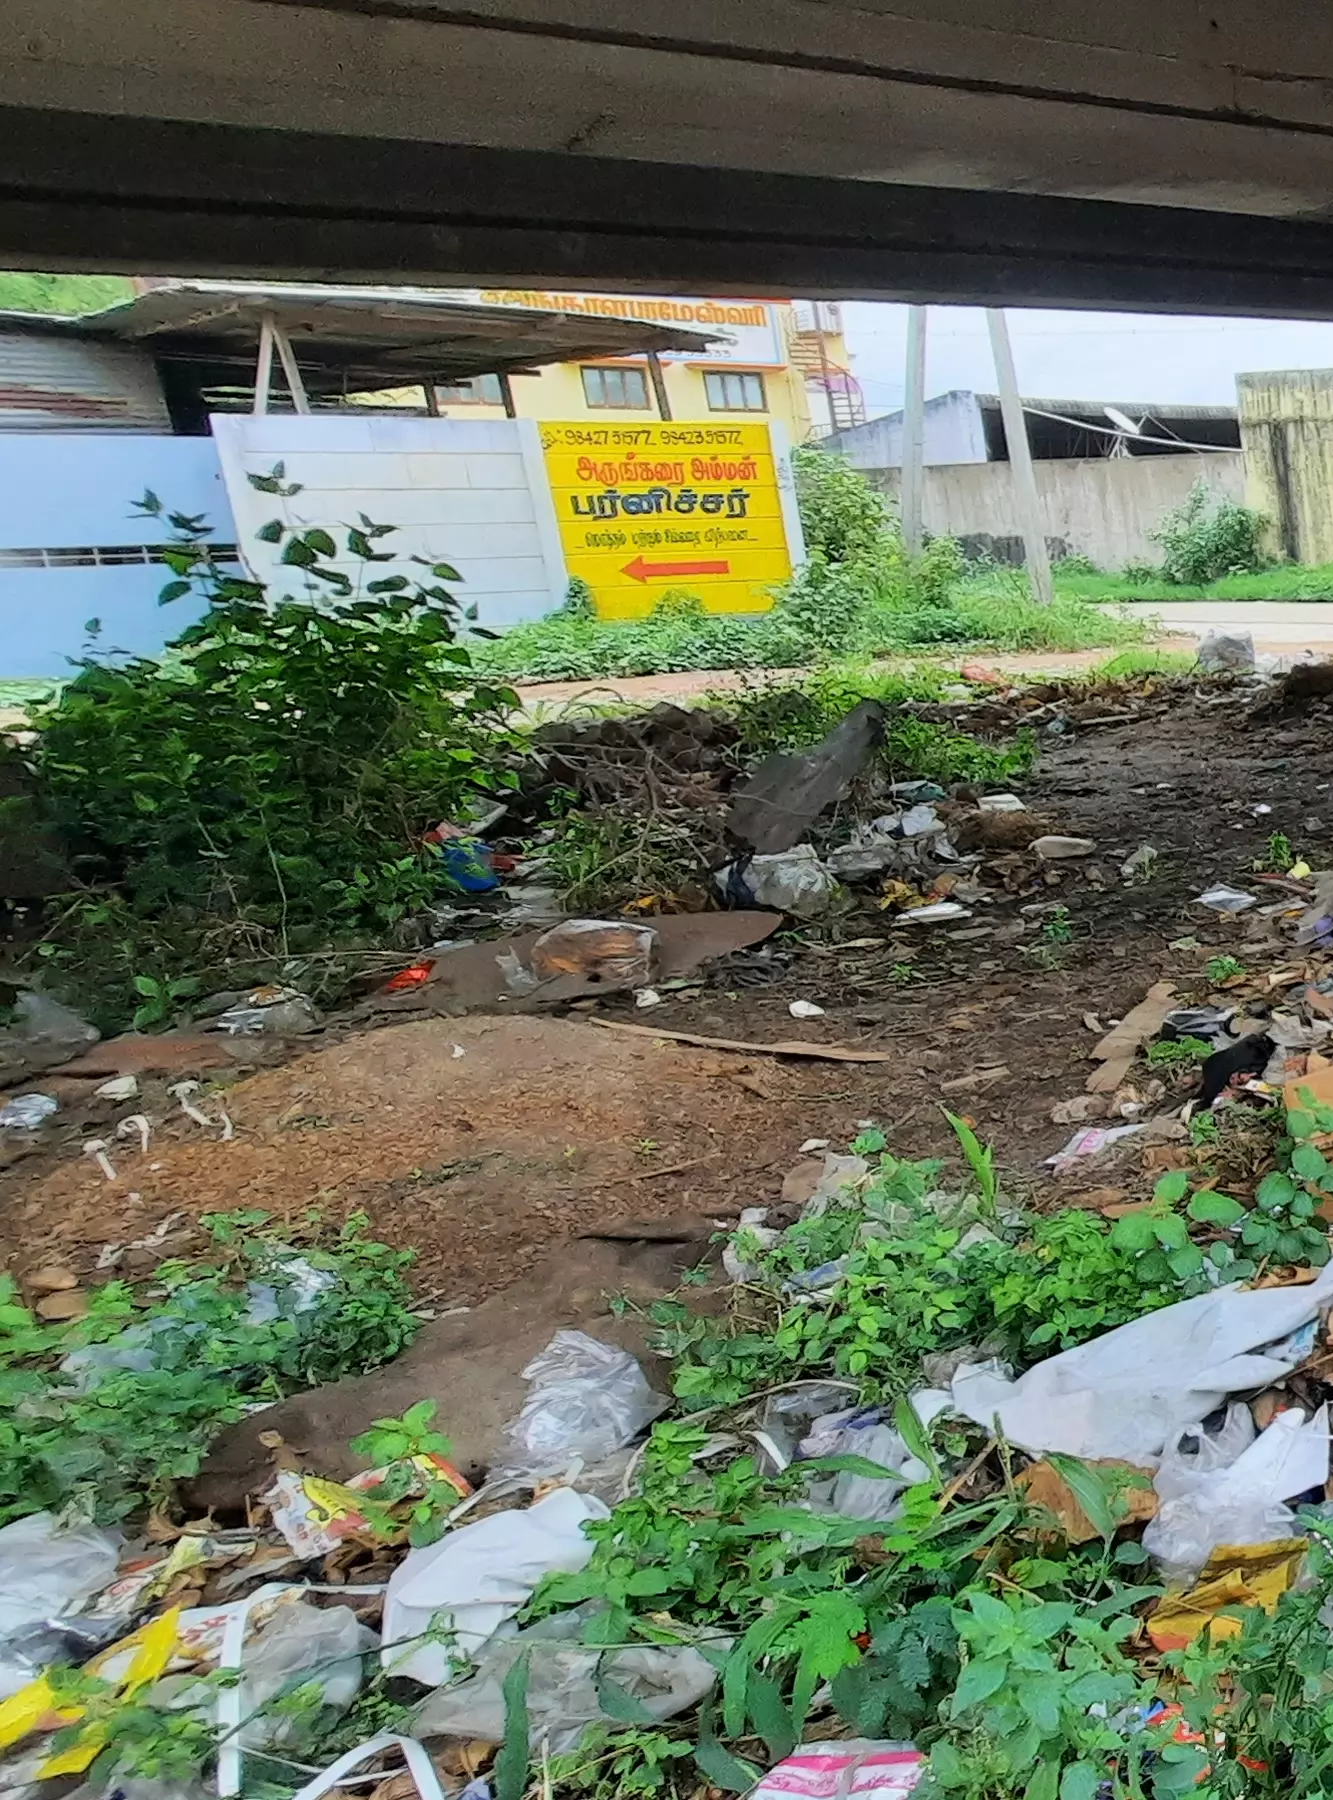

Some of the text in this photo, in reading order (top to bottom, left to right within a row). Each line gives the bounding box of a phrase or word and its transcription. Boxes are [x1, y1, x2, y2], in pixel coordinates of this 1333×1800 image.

[576, 452, 685, 485] அருங்கரை
[691, 454, 758, 481] அம்மன்
[570, 487, 751, 521] பர்னிச்சர்
